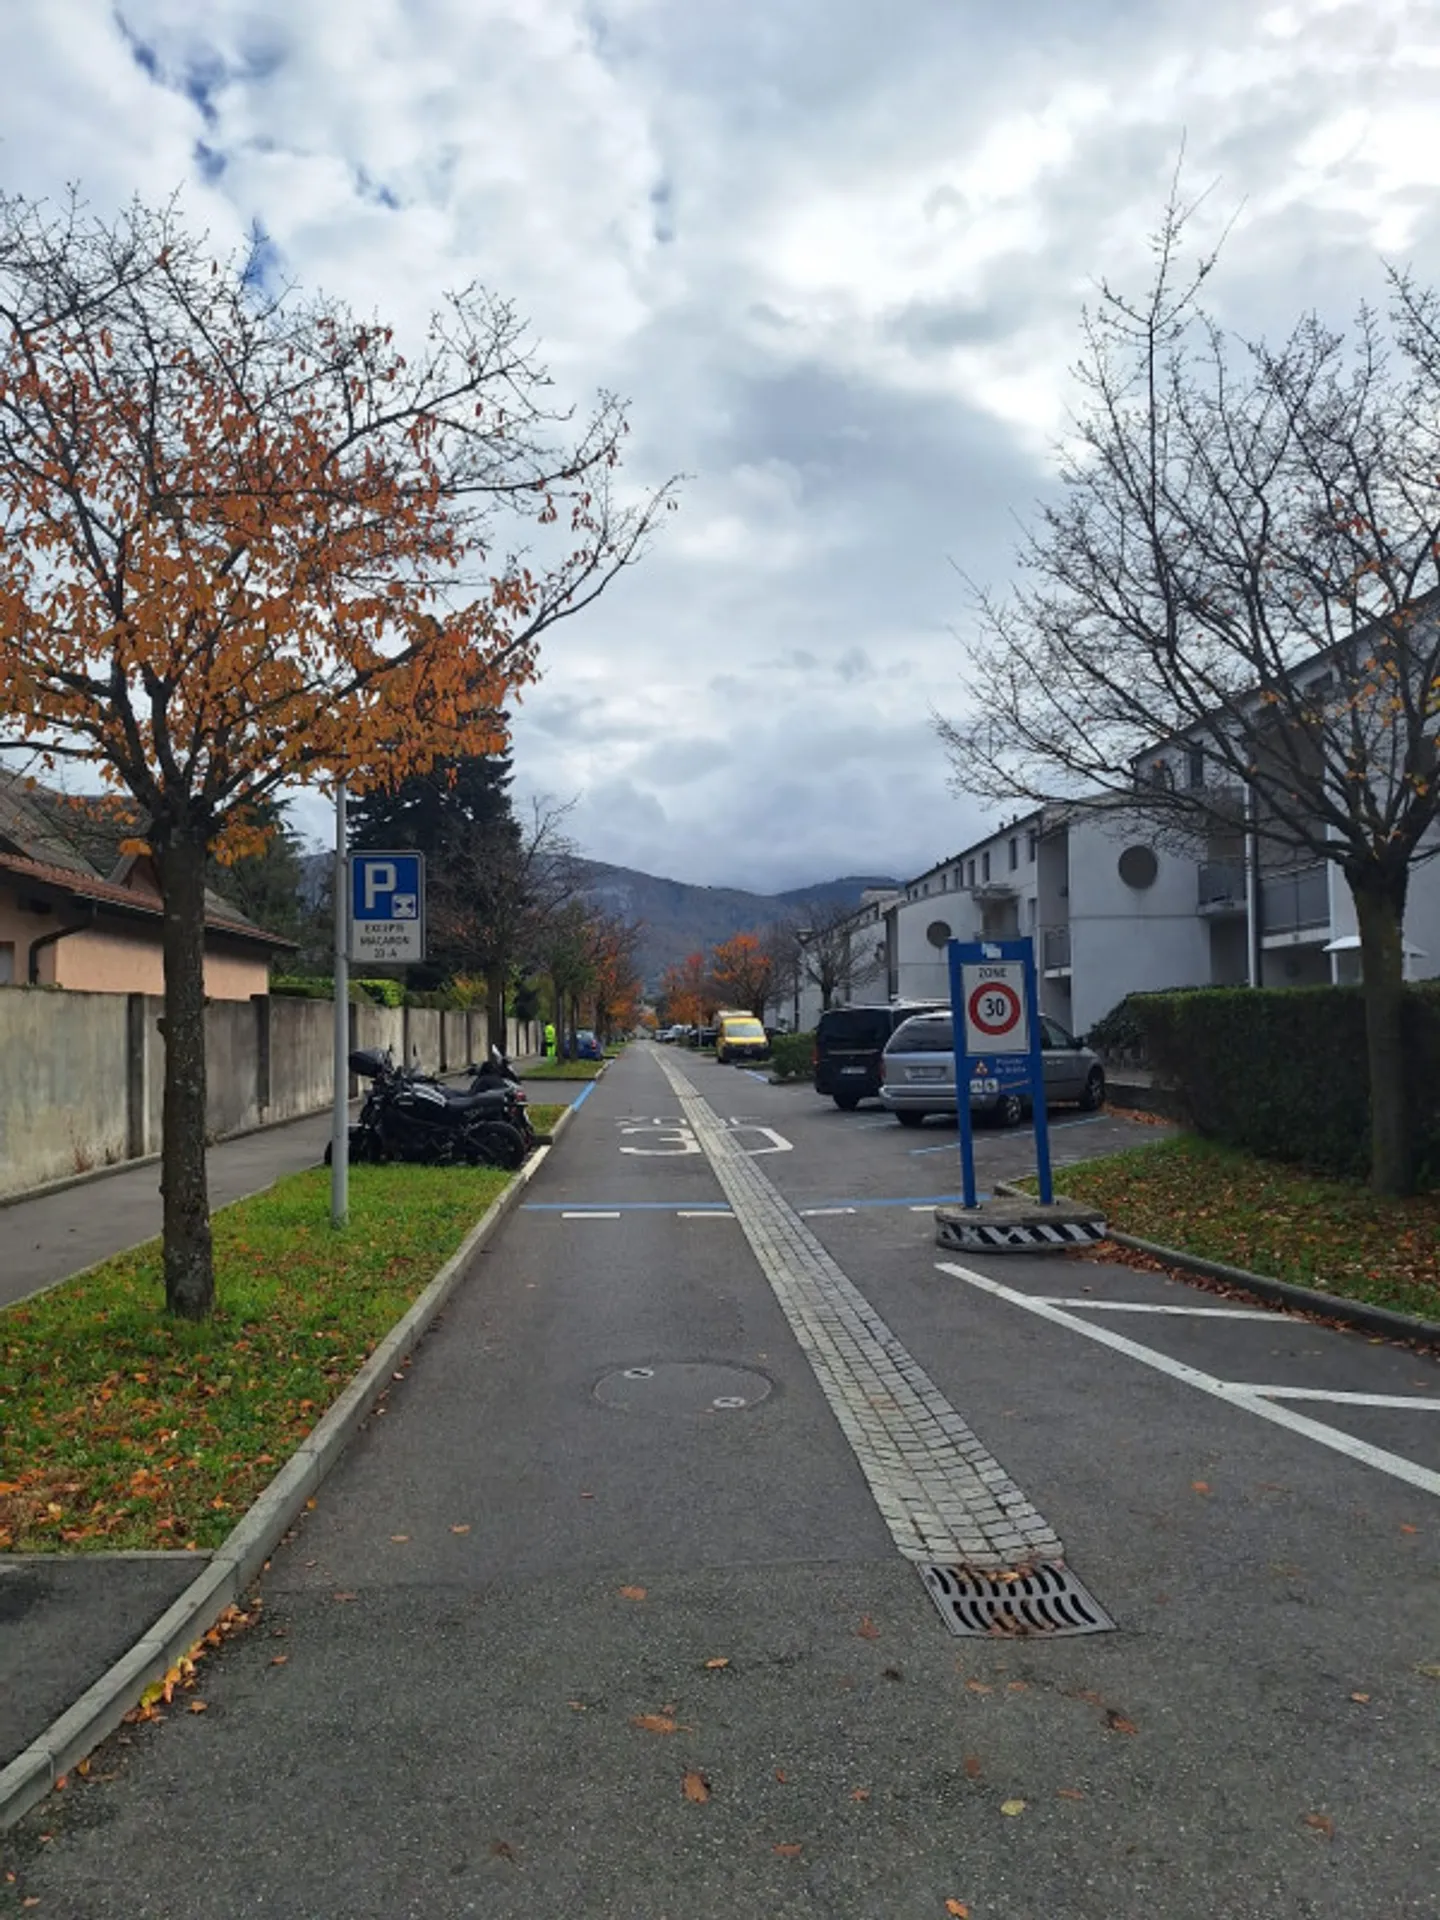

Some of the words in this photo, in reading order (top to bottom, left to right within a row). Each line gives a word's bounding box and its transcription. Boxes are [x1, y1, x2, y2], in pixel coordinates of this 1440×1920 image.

[364, 862, 397, 909] P
[978, 967, 1008, 978] ZONE
[984, 998, 1005, 1017] 30
